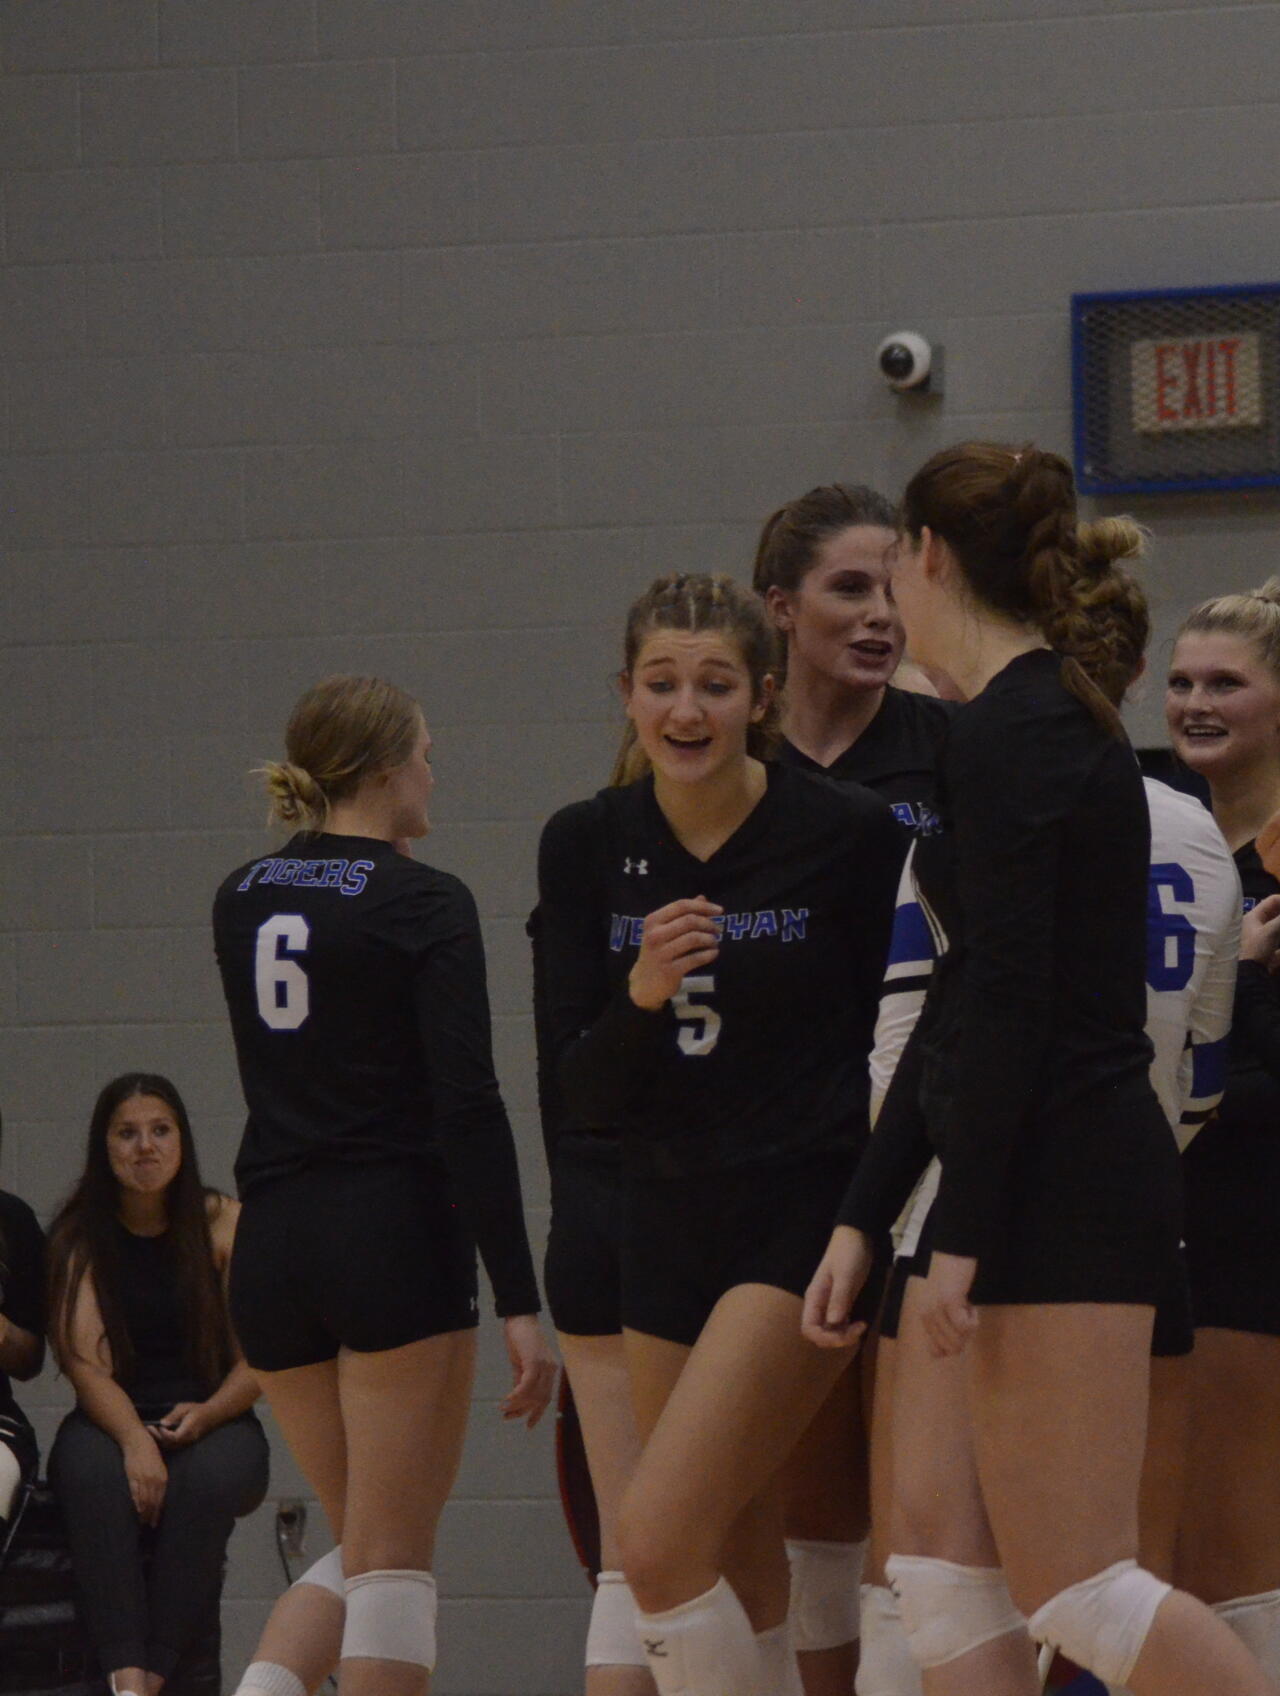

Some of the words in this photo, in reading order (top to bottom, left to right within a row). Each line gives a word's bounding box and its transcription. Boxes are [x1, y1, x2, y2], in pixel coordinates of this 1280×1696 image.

[1156, 338, 1241, 420] EXIT
[236, 858, 375, 896] TIGERS
[609, 908, 809, 952] WEYAN
[256, 913, 311, 1031] 6
[671, 975, 723, 1056] 5
